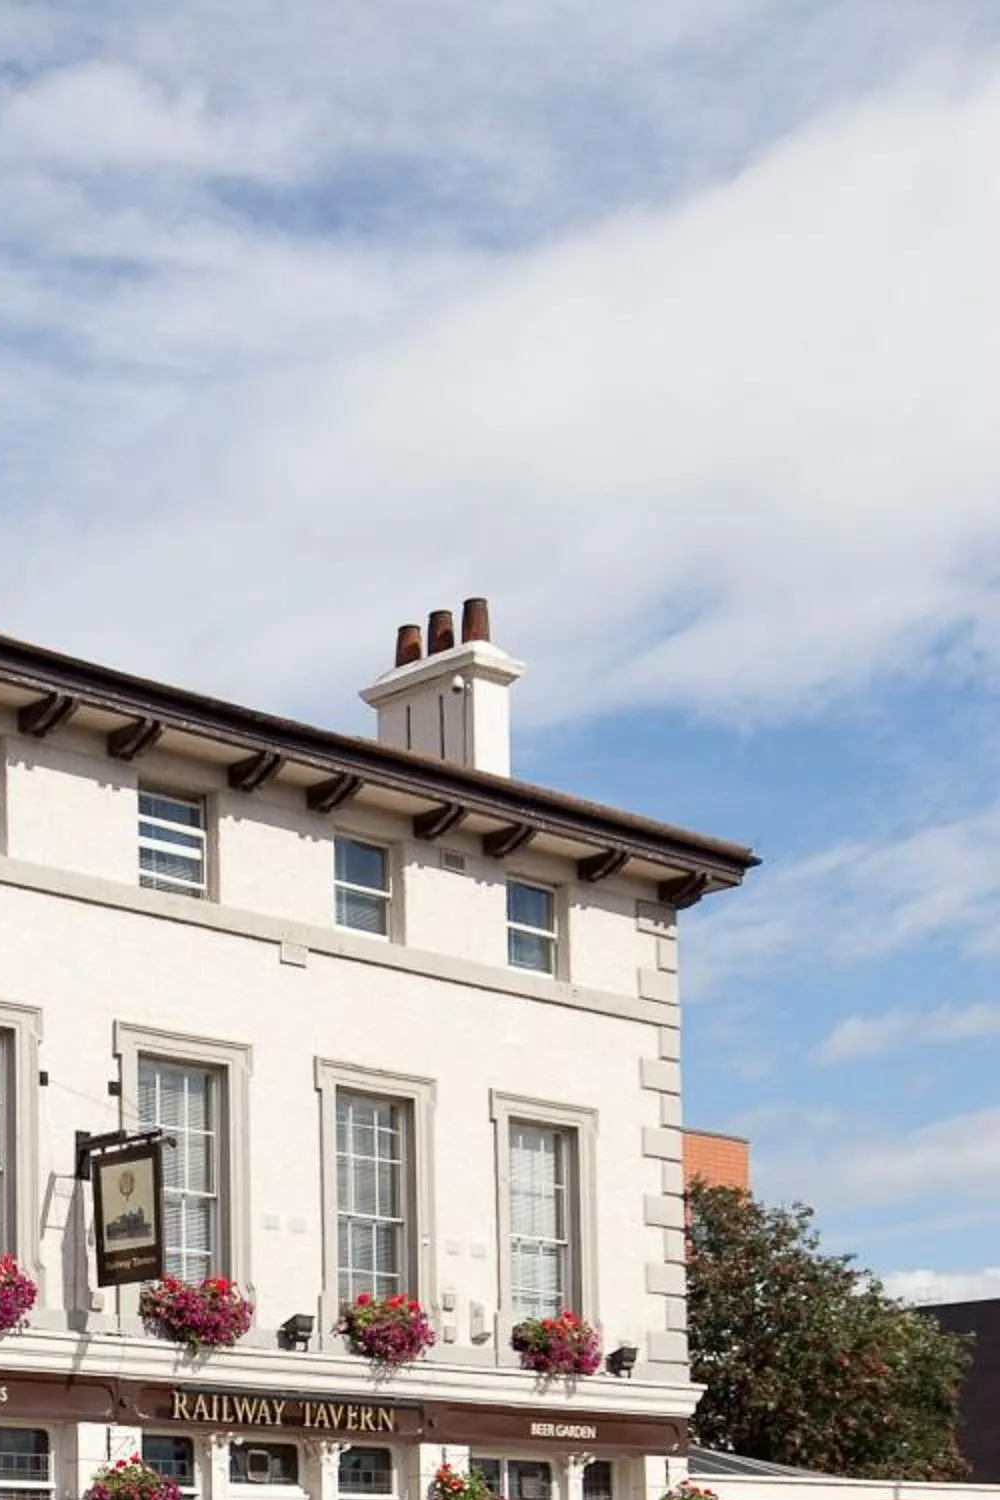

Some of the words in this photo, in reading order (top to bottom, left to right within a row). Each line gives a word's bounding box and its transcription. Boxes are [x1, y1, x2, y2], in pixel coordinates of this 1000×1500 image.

[172, 1391, 286, 1425] RAILWAY
[299, 1400, 395, 1432] TAVERN
[530, 1422, 554, 1437] BEER
[555, 1424, 597, 1439] GARDEN
